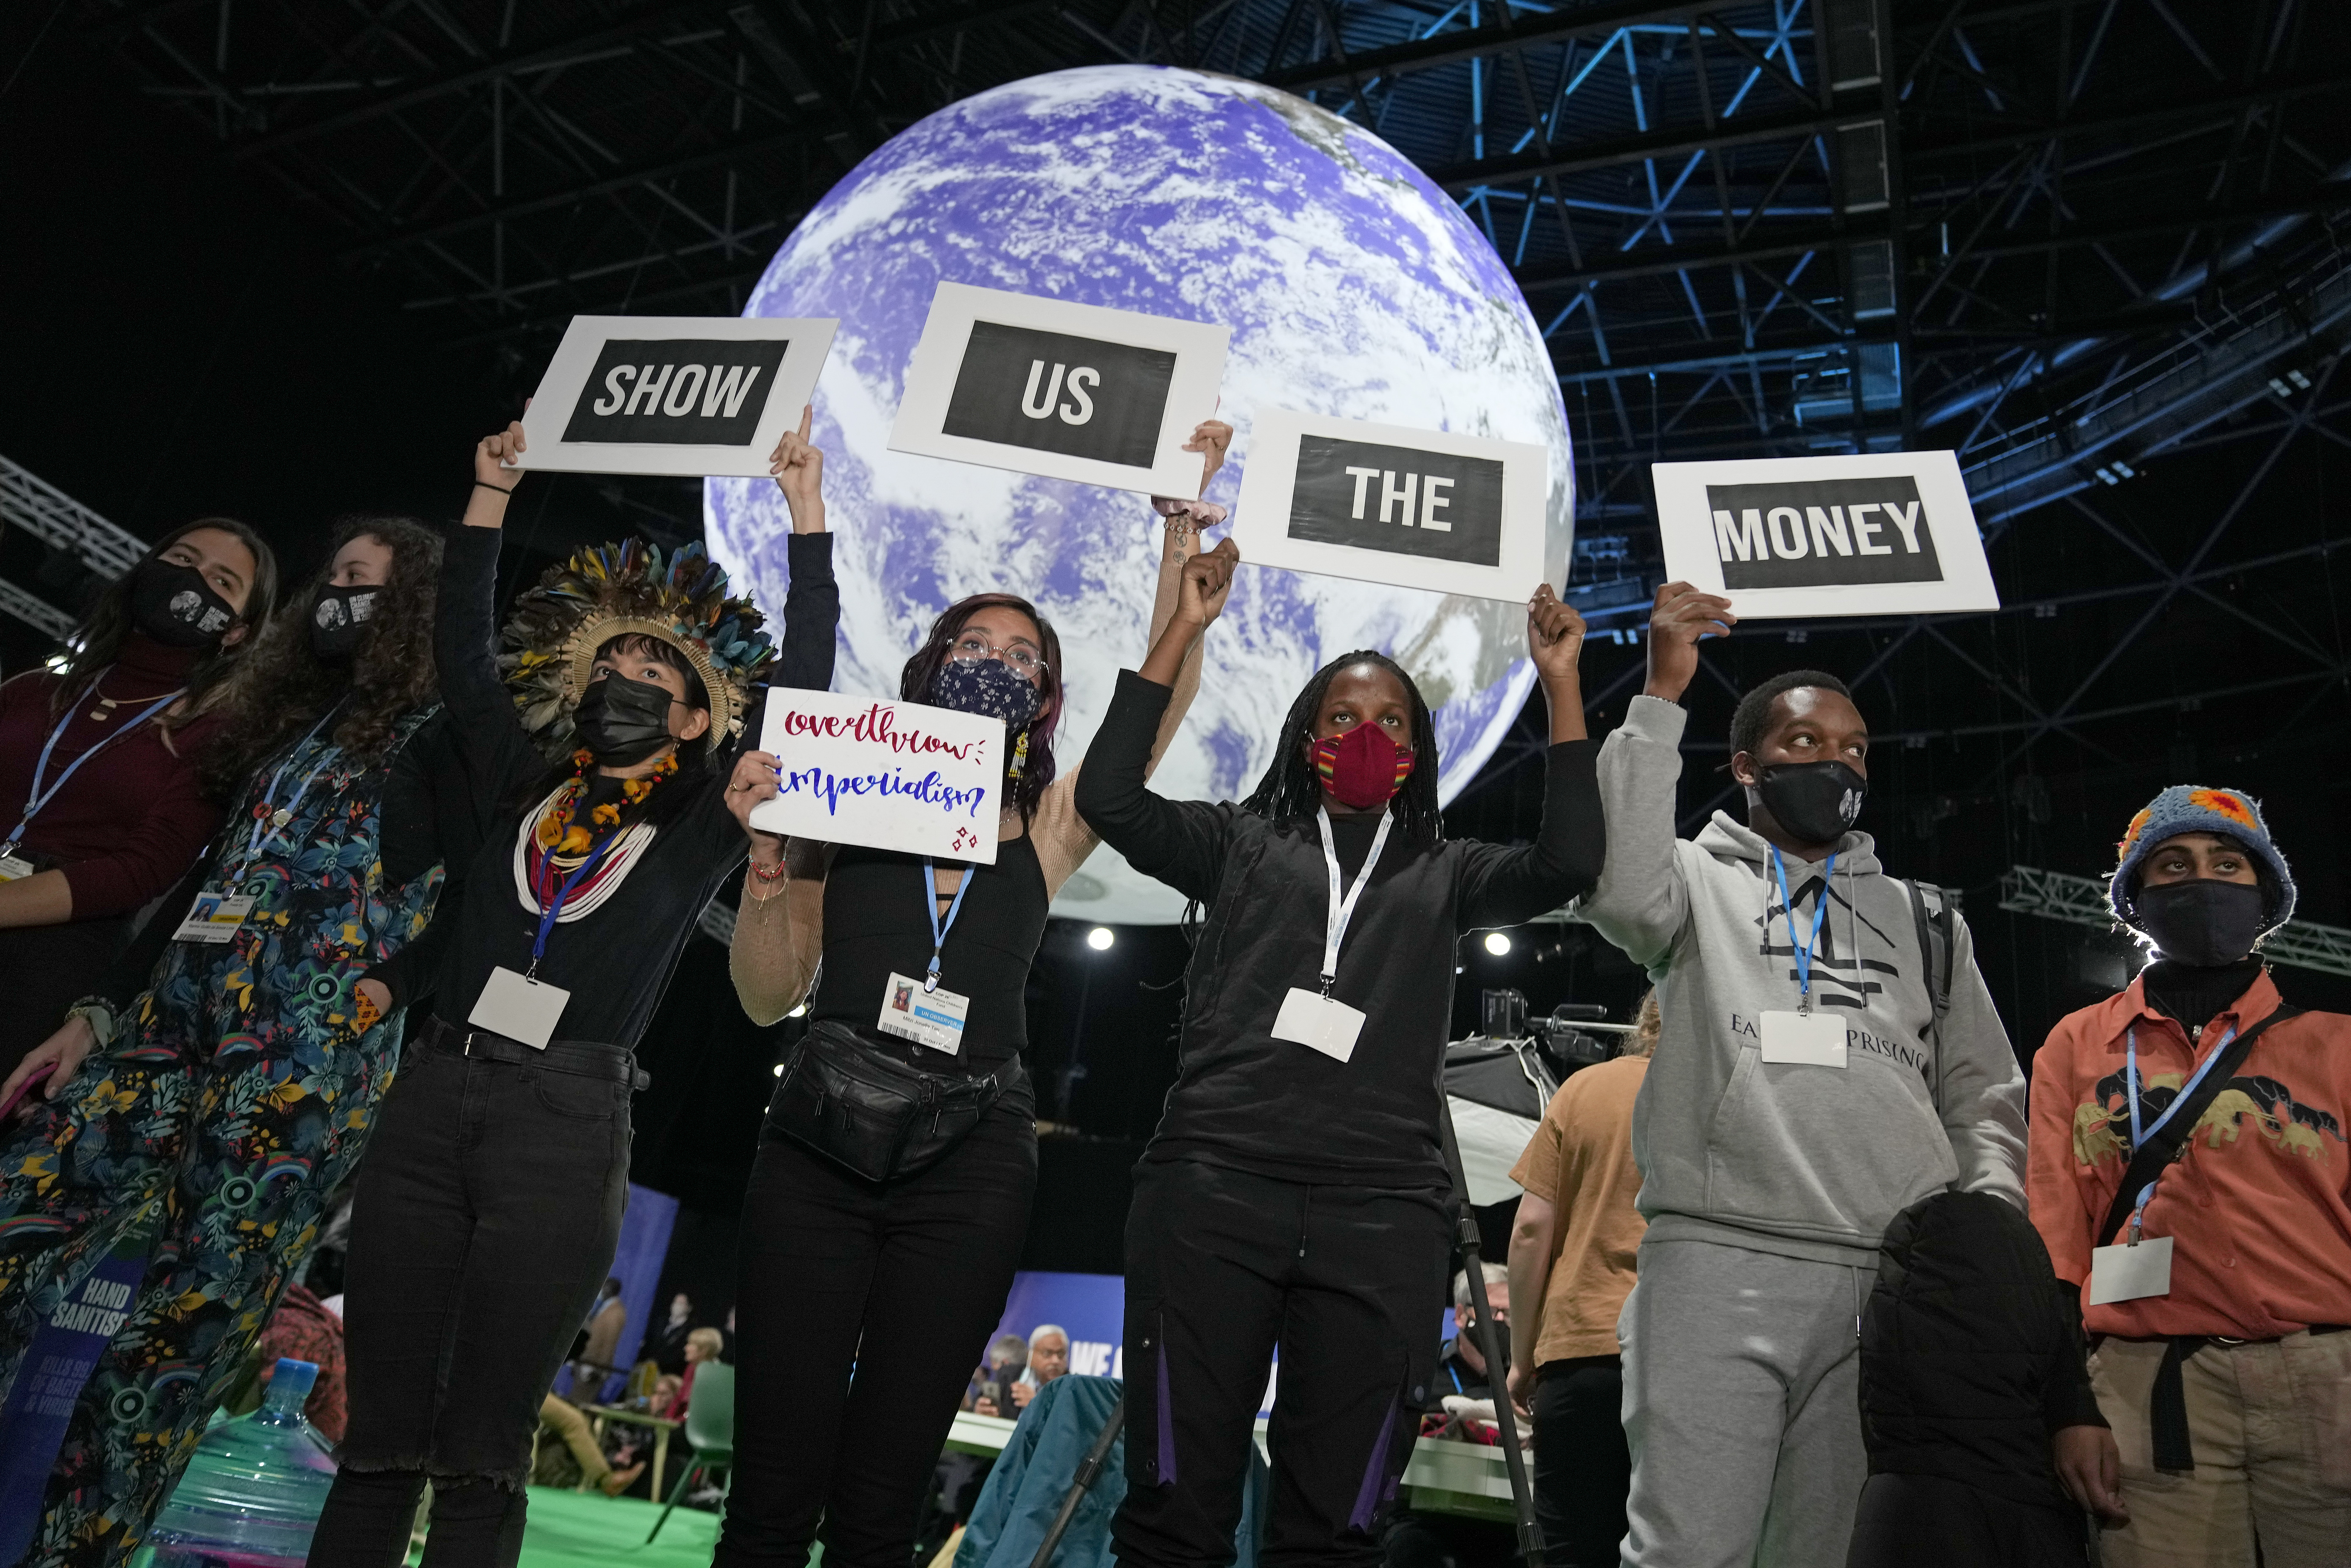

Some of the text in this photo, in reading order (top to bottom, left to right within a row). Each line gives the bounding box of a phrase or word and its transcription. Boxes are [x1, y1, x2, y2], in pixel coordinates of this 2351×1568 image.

[593, 364, 761, 417] SHOW
[1022, 359, 1100, 425] US
[1345, 465, 1455, 532] THE
[1712, 501, 1921, 562] MONEY
[785, 703, 974, 760] overthrow
[930, 1012, 957, 1026] OBSERVER
[946, 1001, 963, 1009] Children's
[1847, 1029, 1924, 1072] PRISING
[81, 1277, 131, 1310] HAND
[1069, 1341, 1113, 1377] WE
